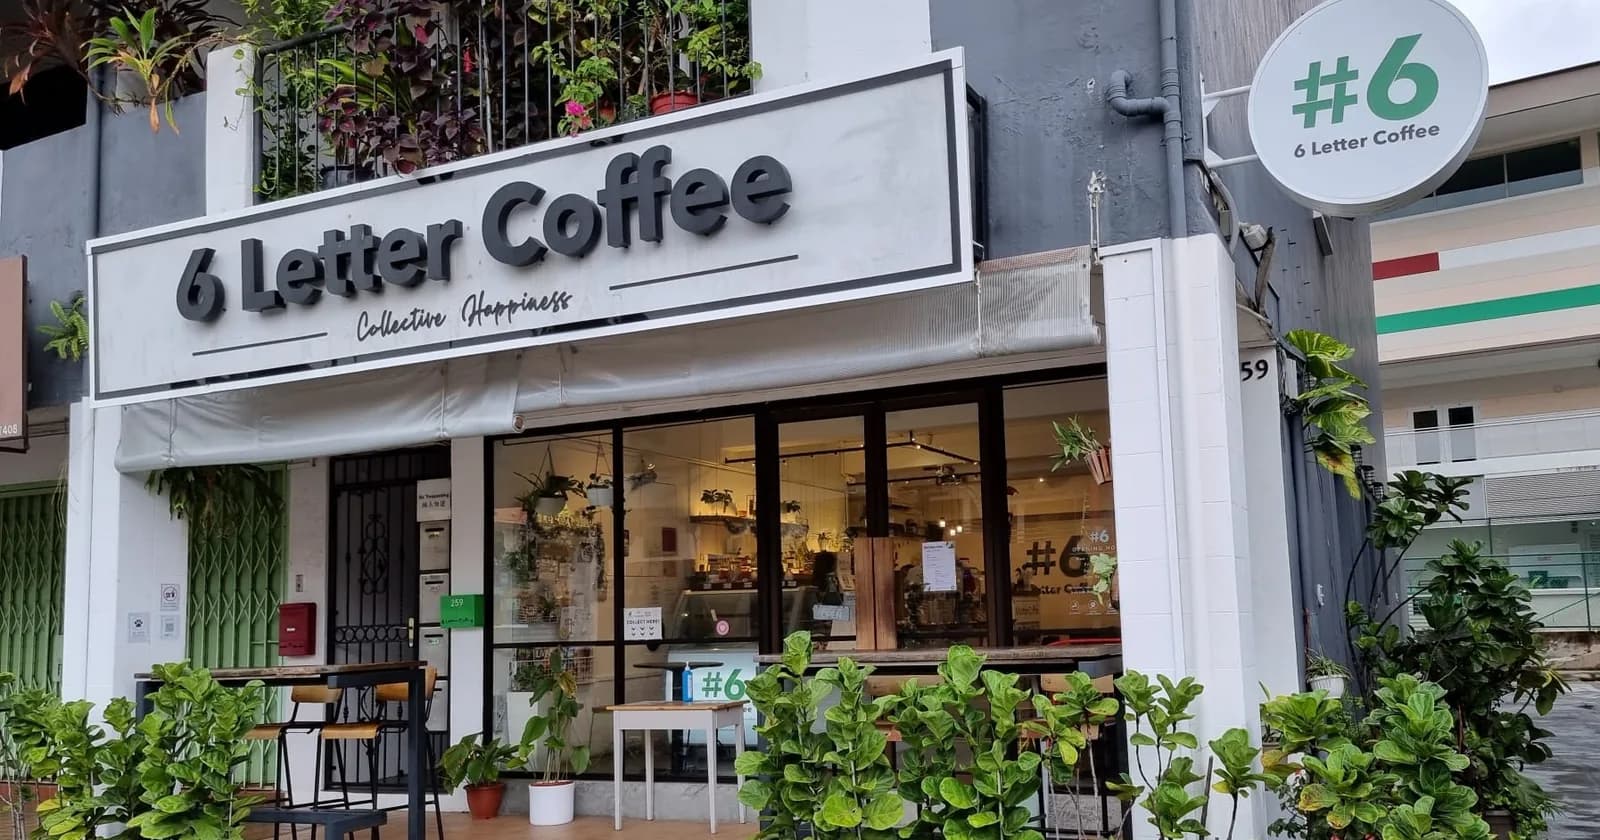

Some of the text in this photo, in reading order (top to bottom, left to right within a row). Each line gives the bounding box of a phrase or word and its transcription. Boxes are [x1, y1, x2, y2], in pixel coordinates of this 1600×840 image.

[1292, 33, 1440, 129] #6
[1294, 124, 1440, 158] 6 Letter Coffee
[176, 145, 793, 322] 6 Letter Coffee
[356, 289, 573, 342] Collective Happiness
[1241, 359, 1269, 382] 59
[1090, 530, 1109, 542] #6
[450, 598, 464, 608] 259
[702, 668, 746, 701] #6
